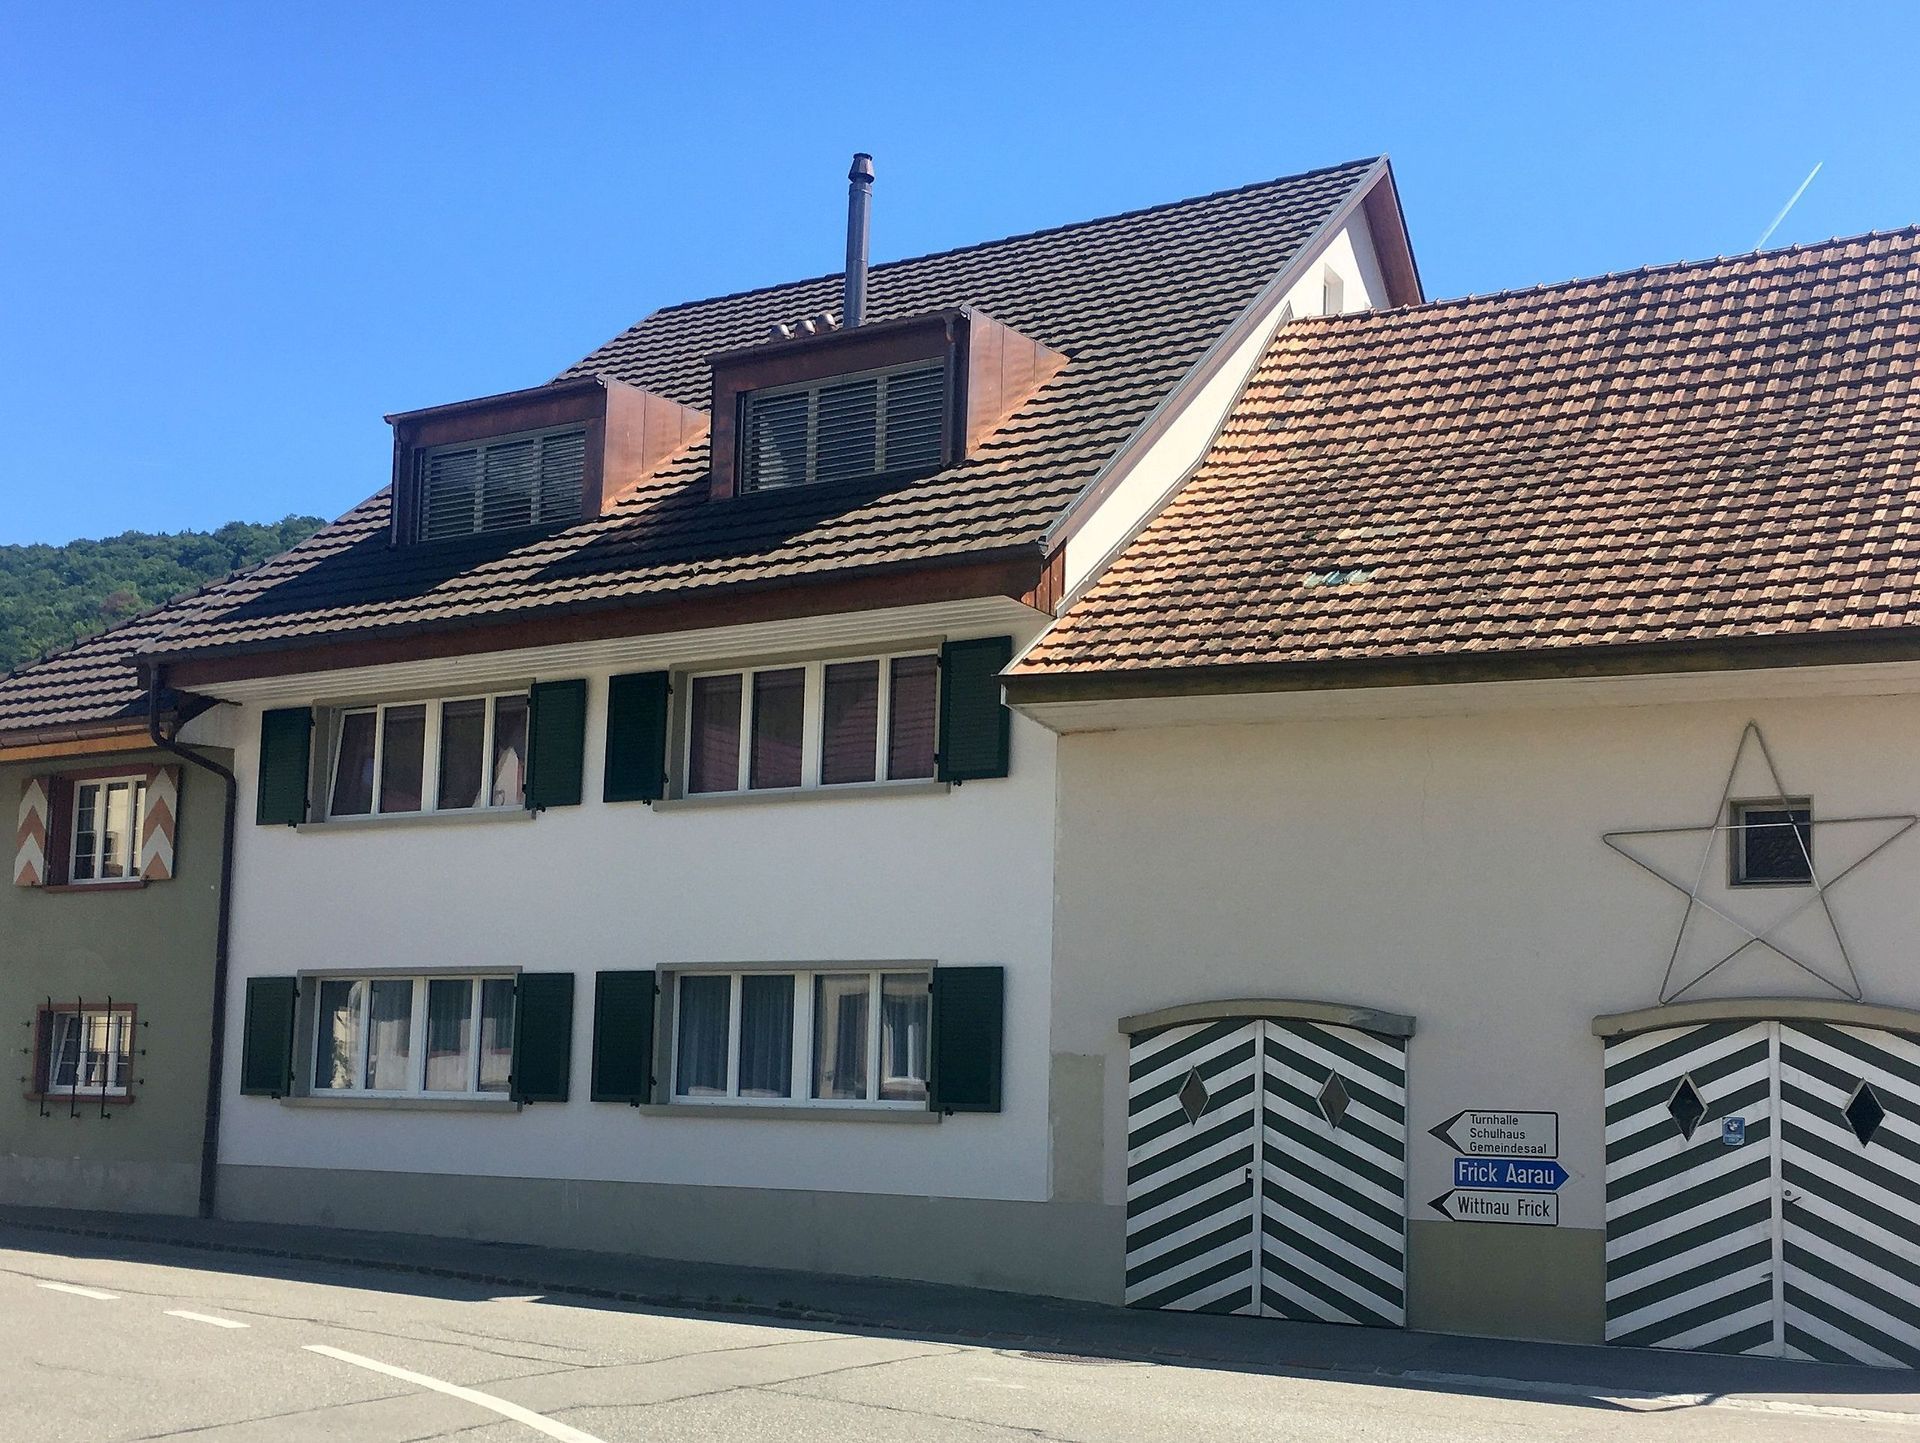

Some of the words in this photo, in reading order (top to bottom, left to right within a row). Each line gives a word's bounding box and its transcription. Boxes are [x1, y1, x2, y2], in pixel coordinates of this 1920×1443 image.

[1470, 1114, 1519, 1125] Turnhalle
[1470, 1128, 1526, 1139] Schulhaus
[1470, 1142, 1547, 1154] Gemeindesaal
[1459, 1161, 1498, 1182] Frick
[1505, 1163, 1555, 1185] Aarau
[1458, 1196, 1510, 1216] Wittnau
[1518, 1199, 1550, 1217] Frick
